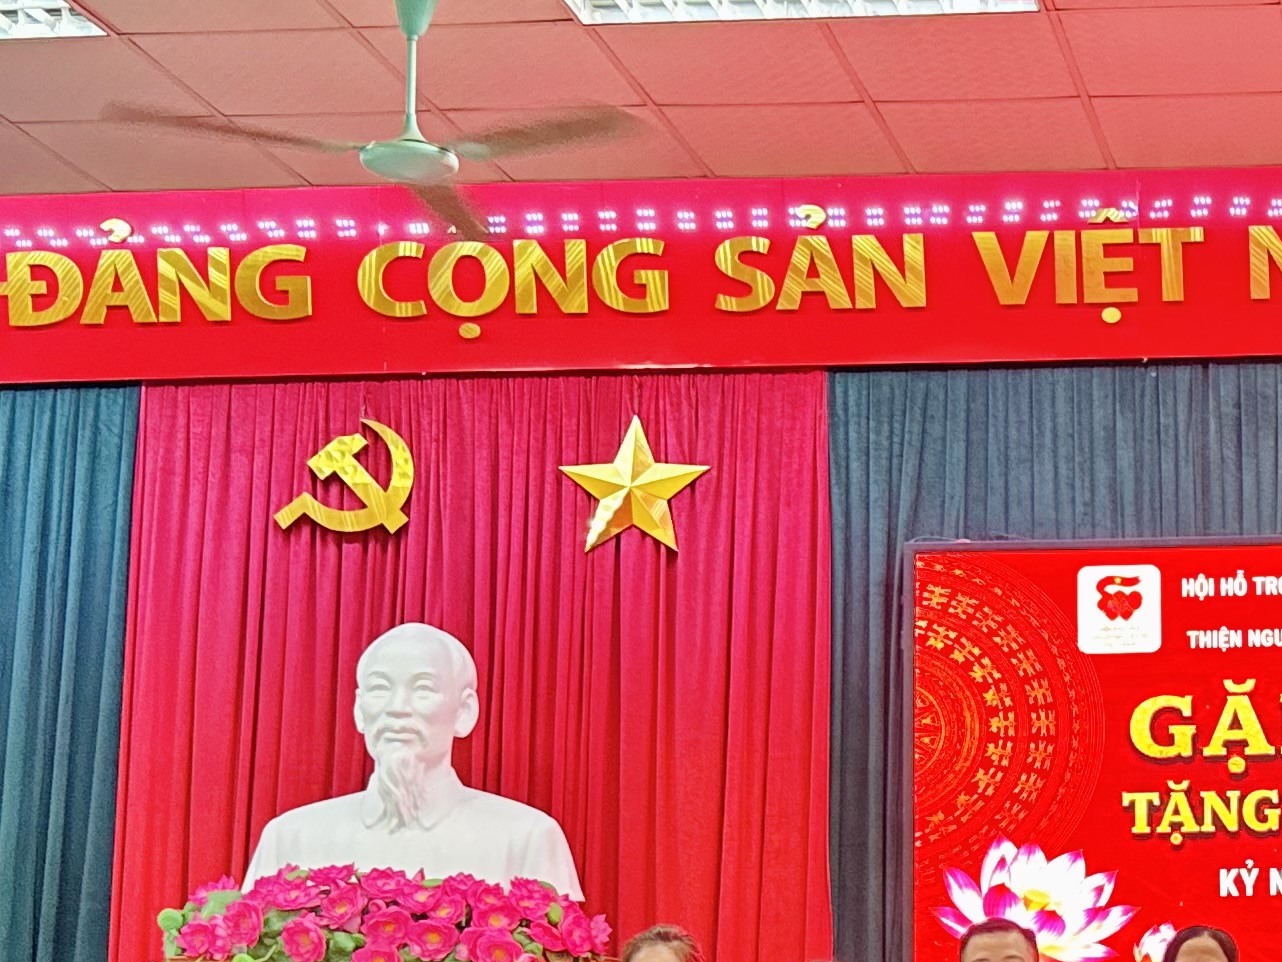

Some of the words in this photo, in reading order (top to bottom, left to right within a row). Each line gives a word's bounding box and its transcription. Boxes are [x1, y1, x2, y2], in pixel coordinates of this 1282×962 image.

[0, 218, 312, 327] ĐẢNG
[715, 204, 926, 311] SẢN
[973, 208, 1204, 323] VIỆT
[1182, 574, 1214, 600] HỘI
[1220, 570, 1247, 596] HỖ
[1187, 626, 1242, 652] THIỆN
[1122, 780, 1281, 844] TẶNG
[1220, 859, 1259, 896] KỶ
